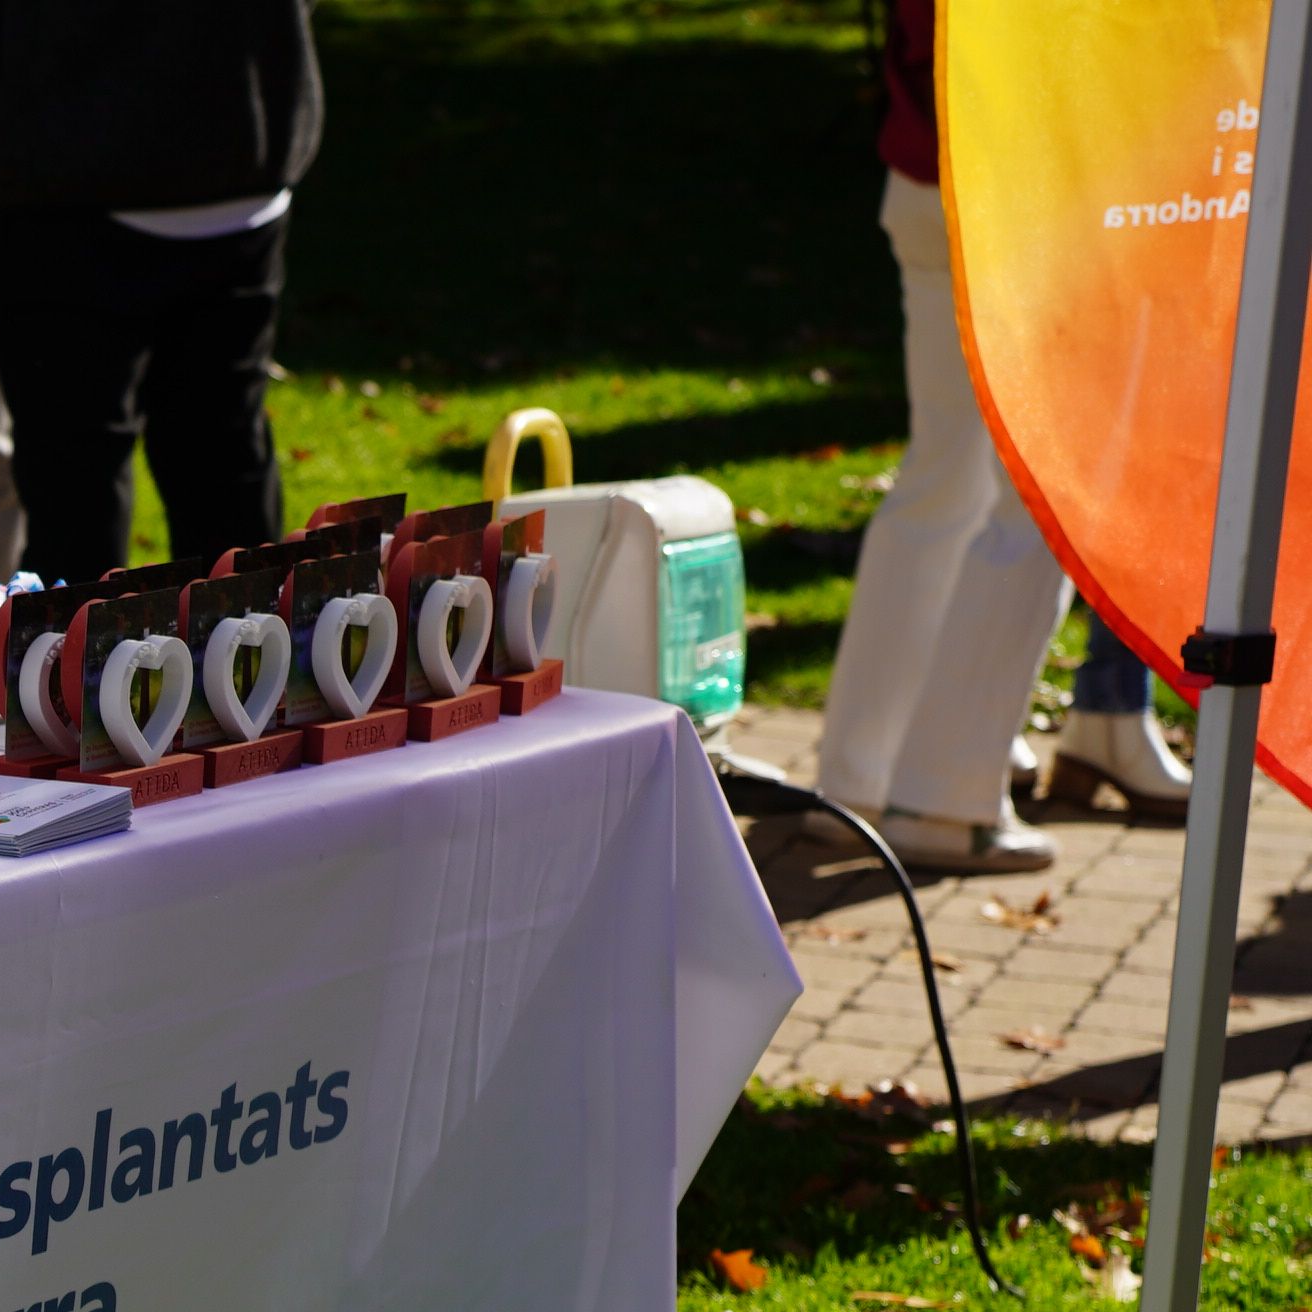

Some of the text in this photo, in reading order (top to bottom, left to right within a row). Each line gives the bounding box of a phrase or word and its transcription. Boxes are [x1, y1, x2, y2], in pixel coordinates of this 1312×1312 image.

[345, 724, 386, 751] ATIDA
[238, 746, 280, 774] ATIDA
[135, 771, 181, 800] ATIDA
